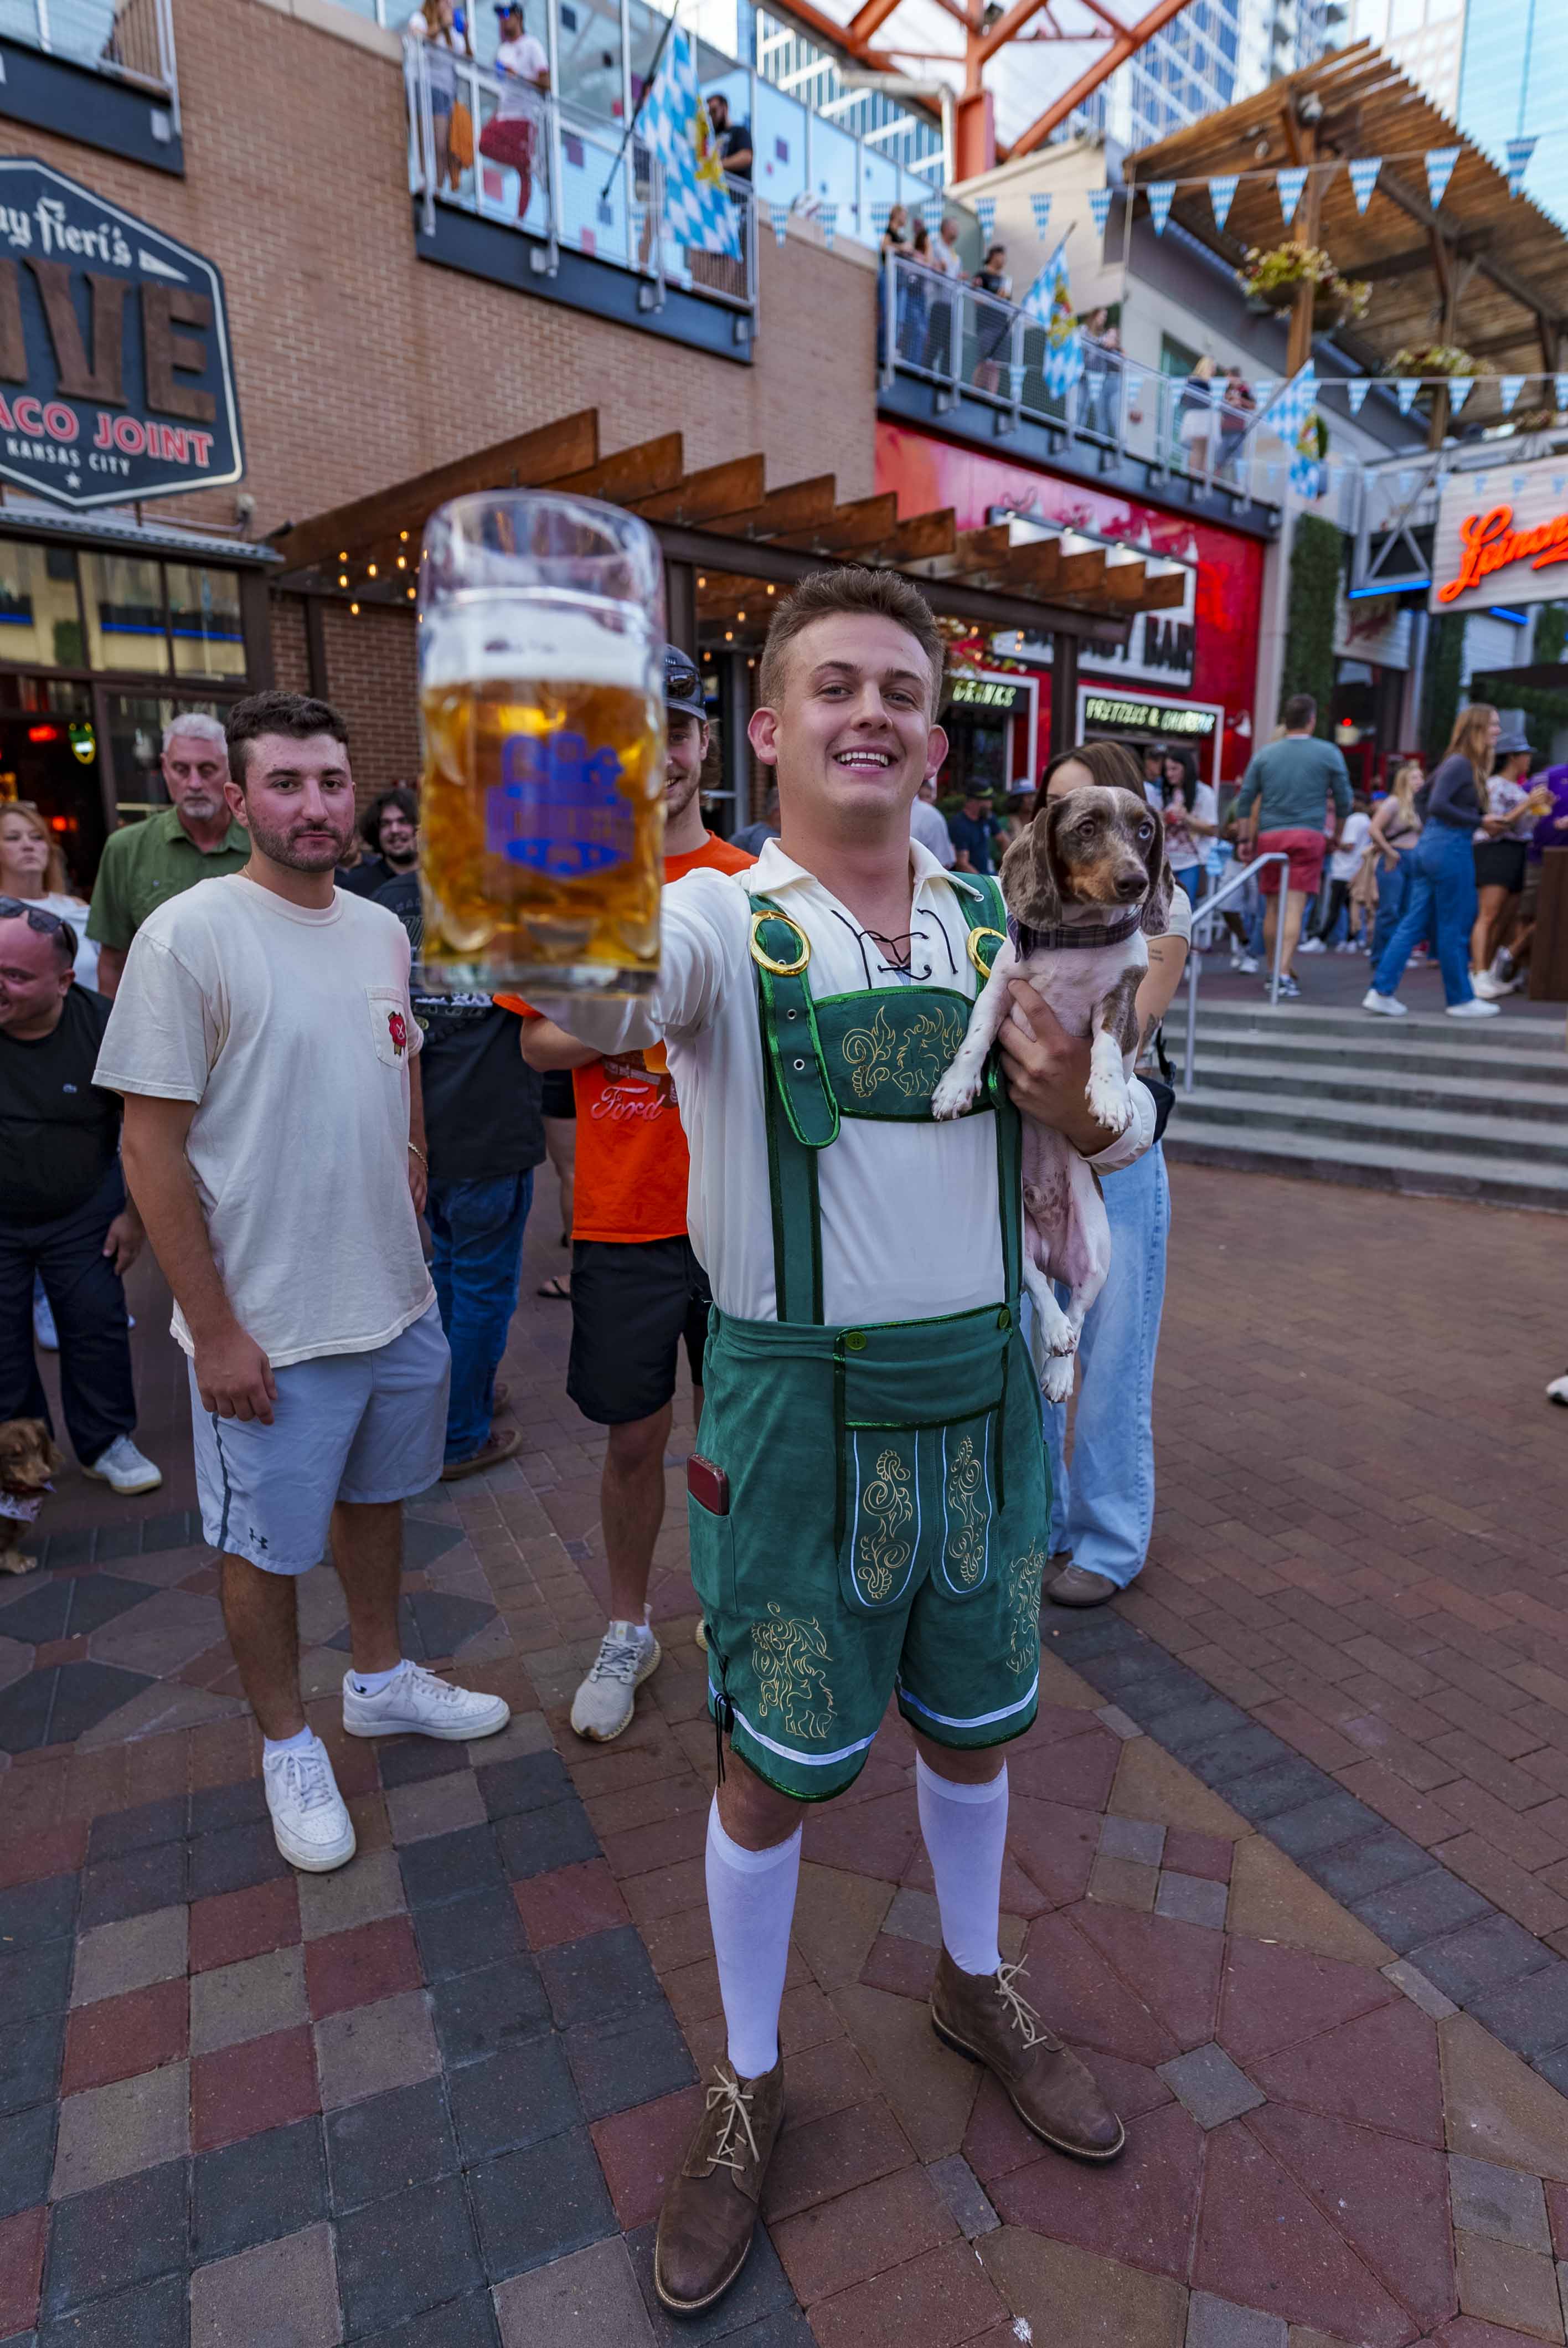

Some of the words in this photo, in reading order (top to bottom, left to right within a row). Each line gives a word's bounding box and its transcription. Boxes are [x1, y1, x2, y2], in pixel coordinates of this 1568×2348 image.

[6, 437, 81, 468] KANSAS
[89, 452, 130, 477] CITY
[93, 411, 213, 467] JOINT
[590, 1086, 666, 1121] Ford
